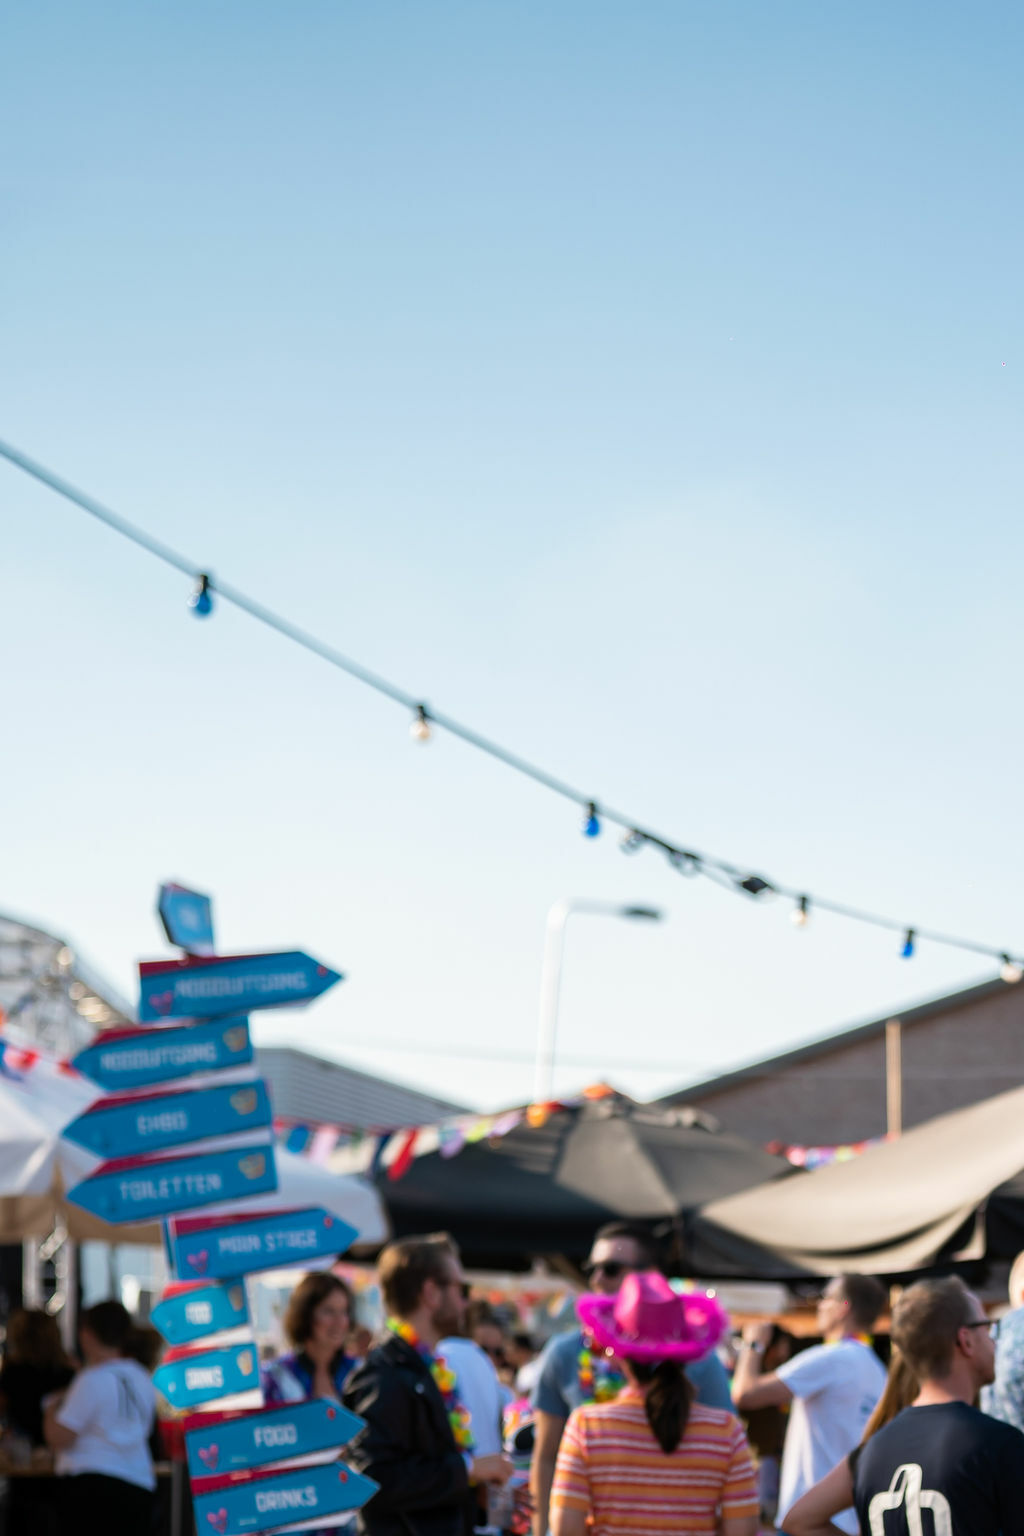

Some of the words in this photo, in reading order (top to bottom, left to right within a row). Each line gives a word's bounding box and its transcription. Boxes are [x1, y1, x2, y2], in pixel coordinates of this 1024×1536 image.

[120, 1173, 222, 1201] TOILETTEN
[254, 1422, 298, 1448] FOOD
[255, 1485, 318, 1513] DRINKS
